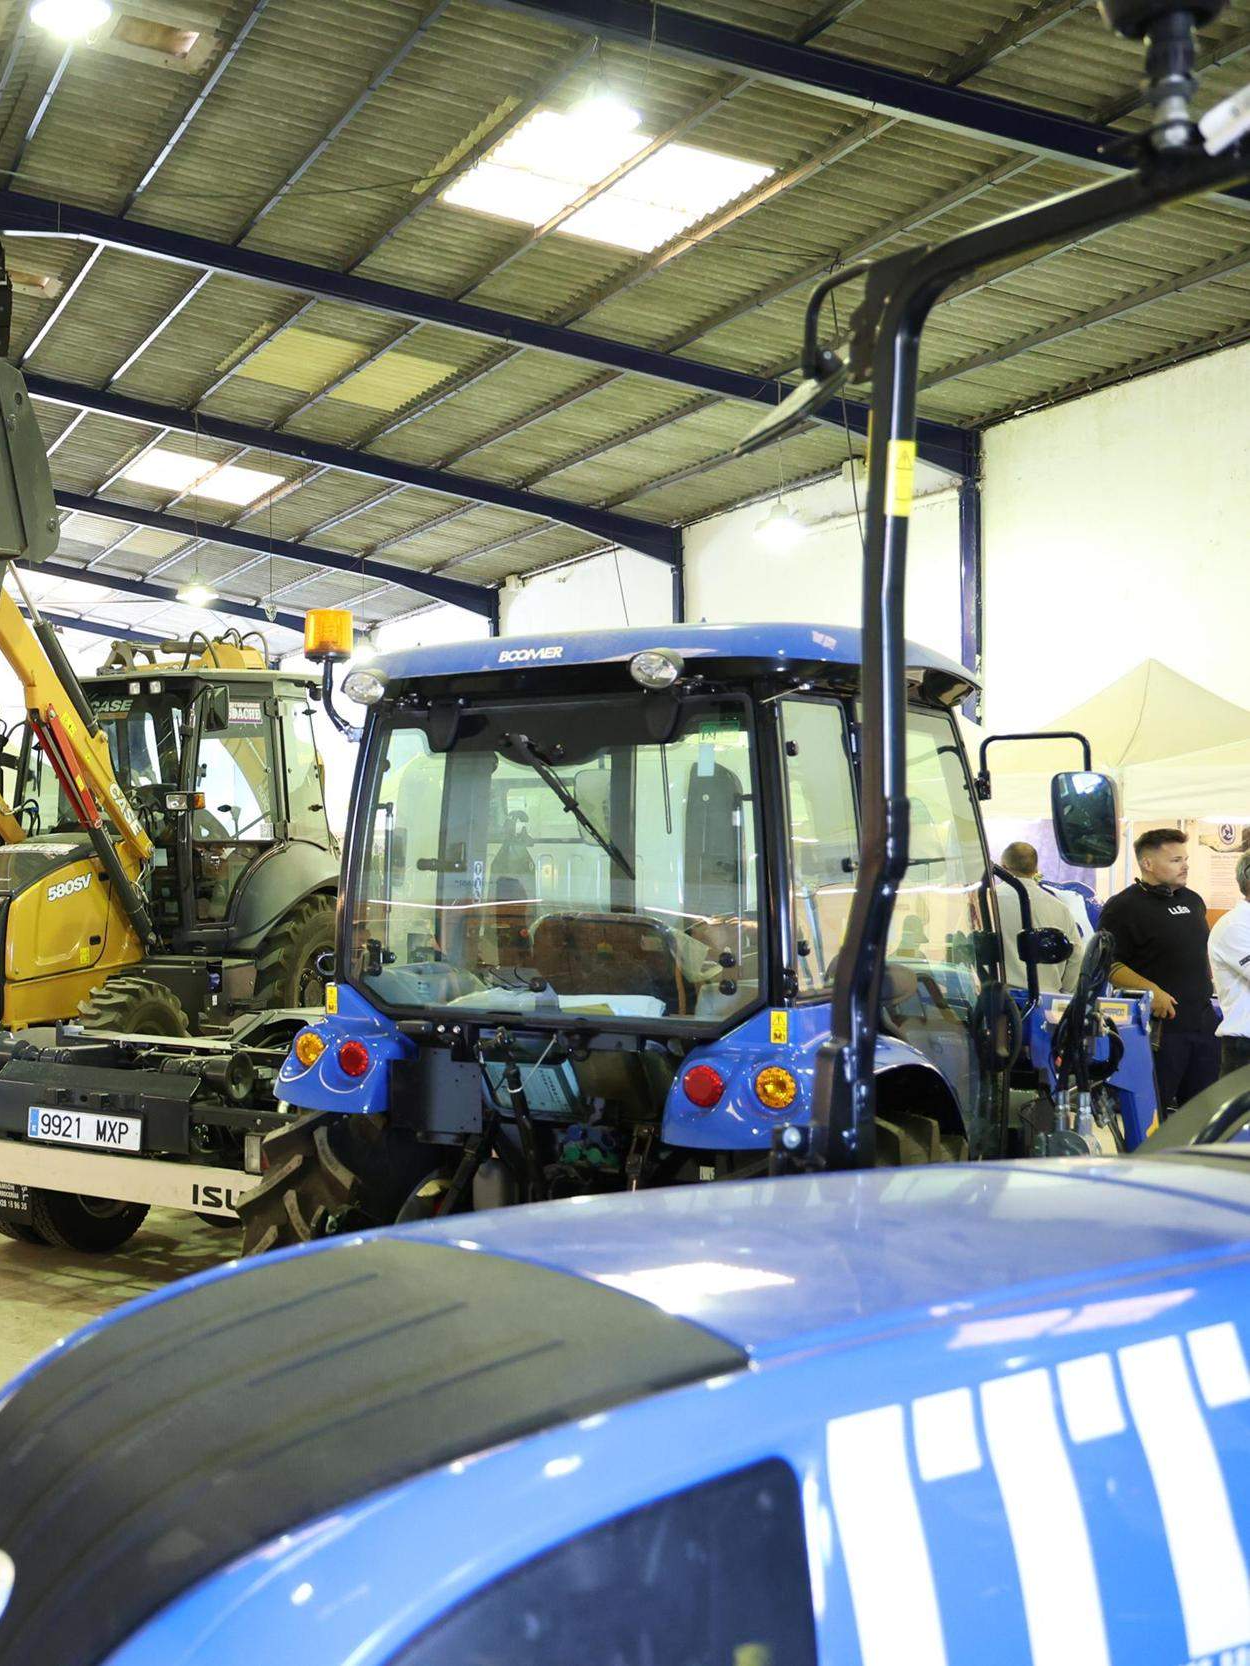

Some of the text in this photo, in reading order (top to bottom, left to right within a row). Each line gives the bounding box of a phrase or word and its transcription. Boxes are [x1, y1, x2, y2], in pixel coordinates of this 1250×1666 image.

[498, 646, 563, 663] BOOMER
[90, 699, 134, 712] CASE
[109, 782, 143, 835] CASE
[47, 872, 92, 902] 580SV
[40, 1113, 81, 1140] 9921
[96, 1120, 129, 1144] MXP
